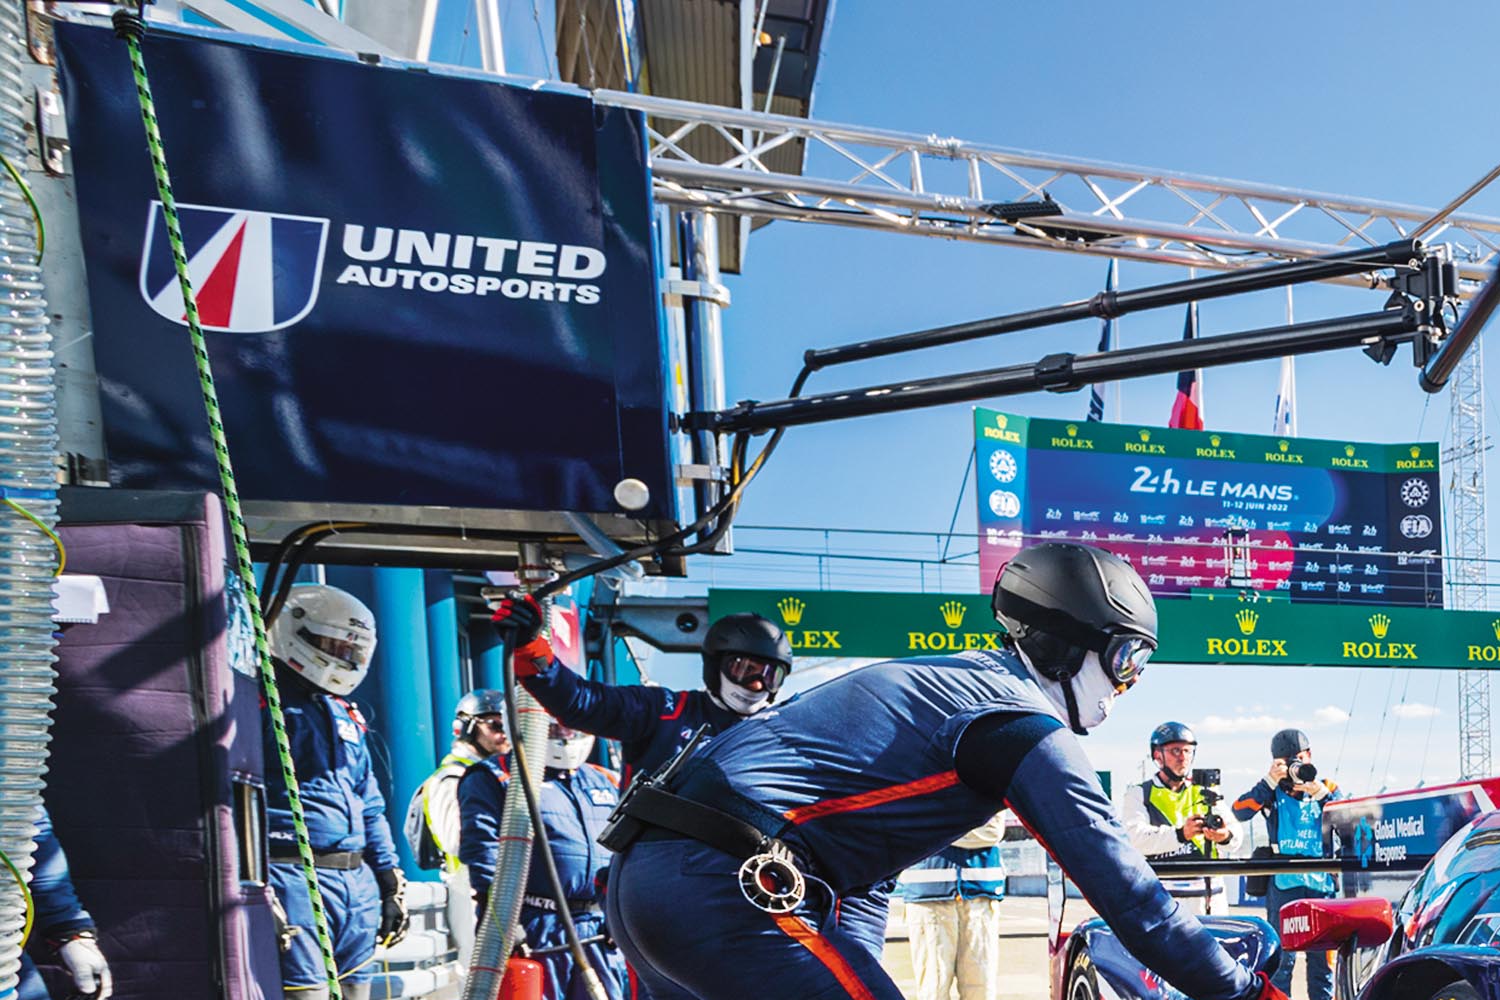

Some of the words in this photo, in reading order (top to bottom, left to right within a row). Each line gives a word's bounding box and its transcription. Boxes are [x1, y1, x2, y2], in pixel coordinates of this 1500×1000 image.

[342, 224, 607, 281] UNITED
[336, 263, 602, 305] AUTOSPORTS
[984, 426, 1021, 443] ROLEX
[1052, 437, 1094, 449] ROLEX
[1125, 442, 1166, 454] ROLEX
[1196, 447, 1236, 459] ROLEX
[1265, 452, 1303, 464] ROLEX
[1331, 457, 1368, 468] ROLEX
[1396, 459, 1434, 469] ROLEX
[1186, 480, 1217, 496] LE
[1221, 482, 1293, 501] MANS
[1222, 500, 1244, 509] 11-12
[1245, 502, 1265, 510] JUIN
[1266, 503, 1288, 512] 2022
[788, 631, 841, 649] LEX
[908, 633, 998, 650] ROLEX
[1207, 639, 1288, 656] ROLEX
[1343, 642, 1418, 659] ROLEX
[1374, 819, 1396, 841] Global
[1396, 815, 1424, 838] Medical
[1375, 842, 1406, 867] Response
[1283, 915, 1310, 934] MOTUL
